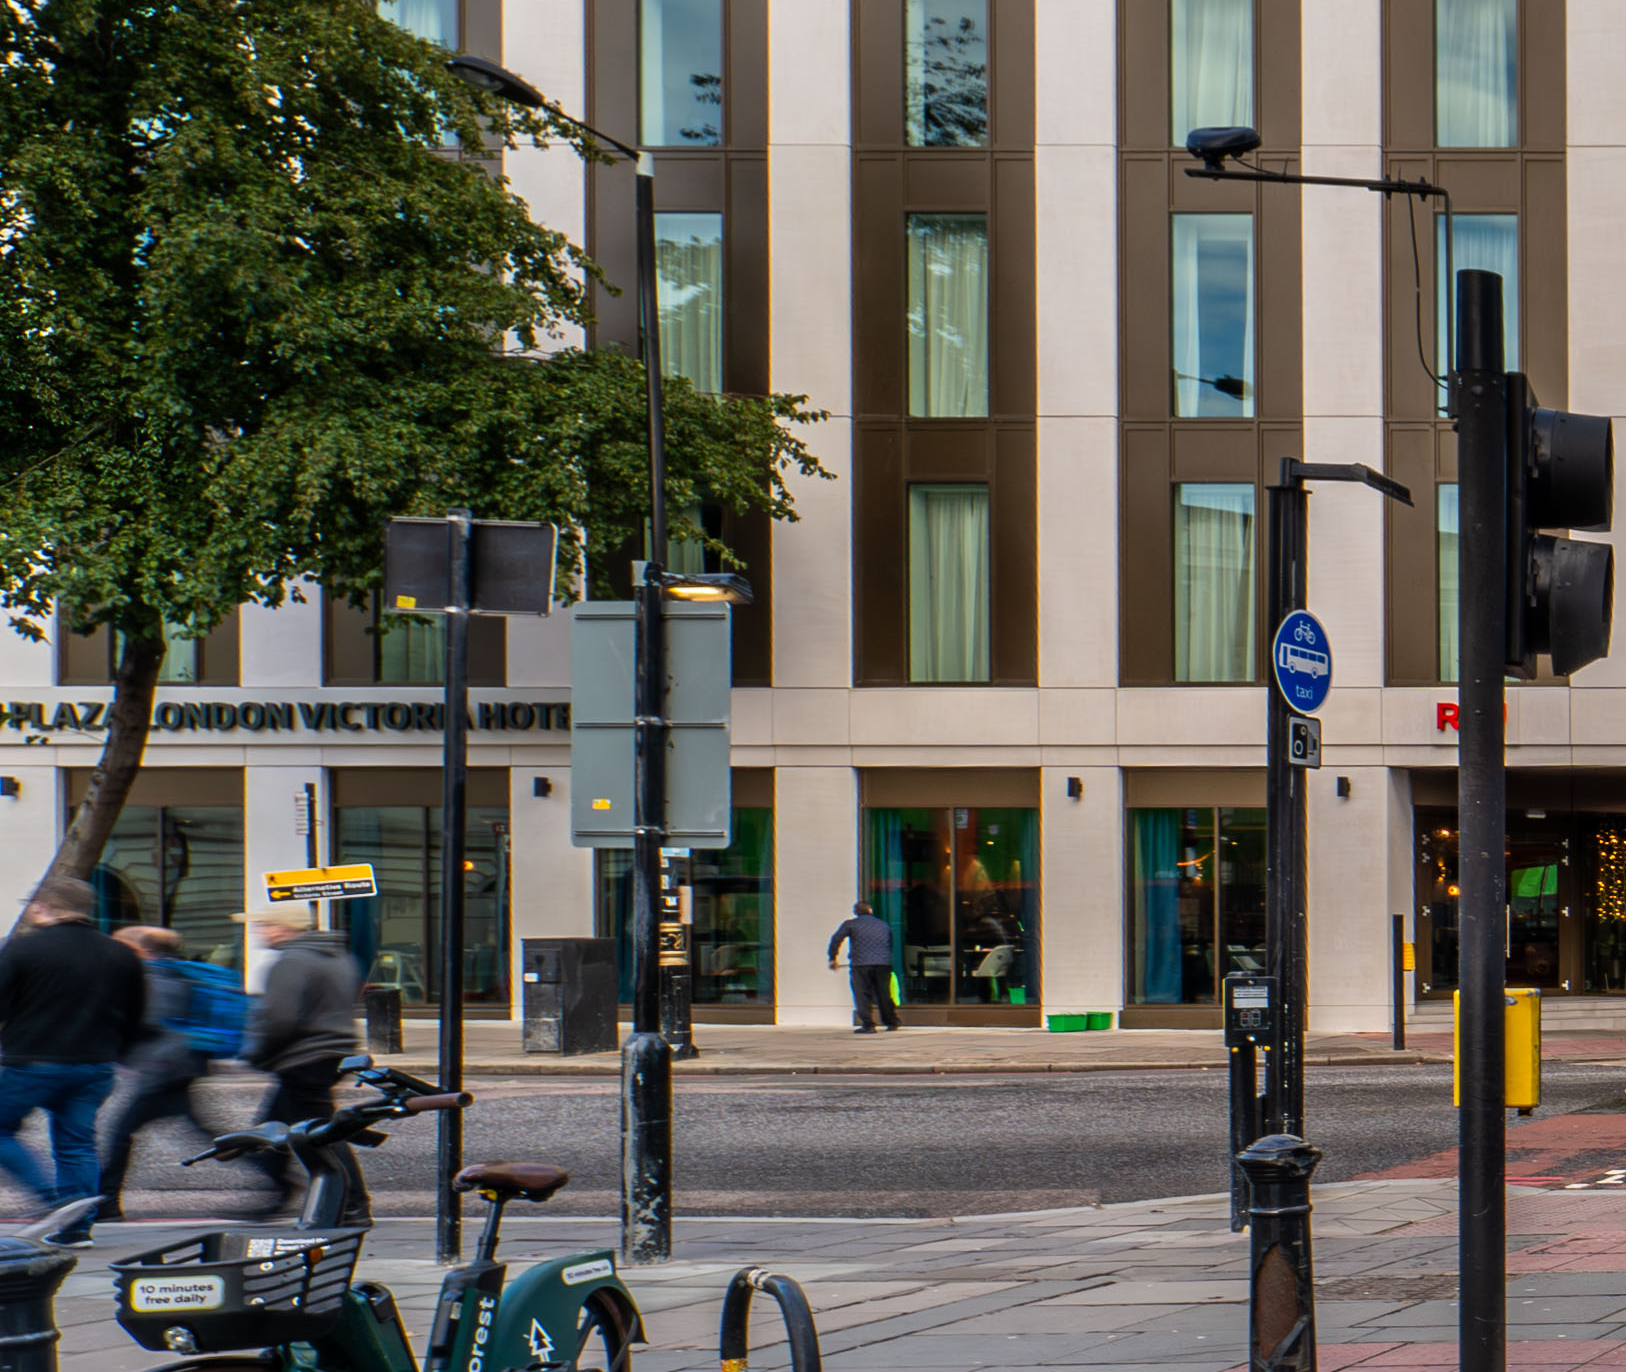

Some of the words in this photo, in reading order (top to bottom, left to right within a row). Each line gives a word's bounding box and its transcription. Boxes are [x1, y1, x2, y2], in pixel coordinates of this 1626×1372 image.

[1295, 683, 1313, 701] taxi
[150, 702, 295, 731] ONDON
[298, 702, 475, 731] VICTORI
[139, 1285, 156, 1293] 10
[159, 1283, 214, 1293] minutes
[145, 1295, 175, 1305] free
[179, 1293, 207, 1305] daily
